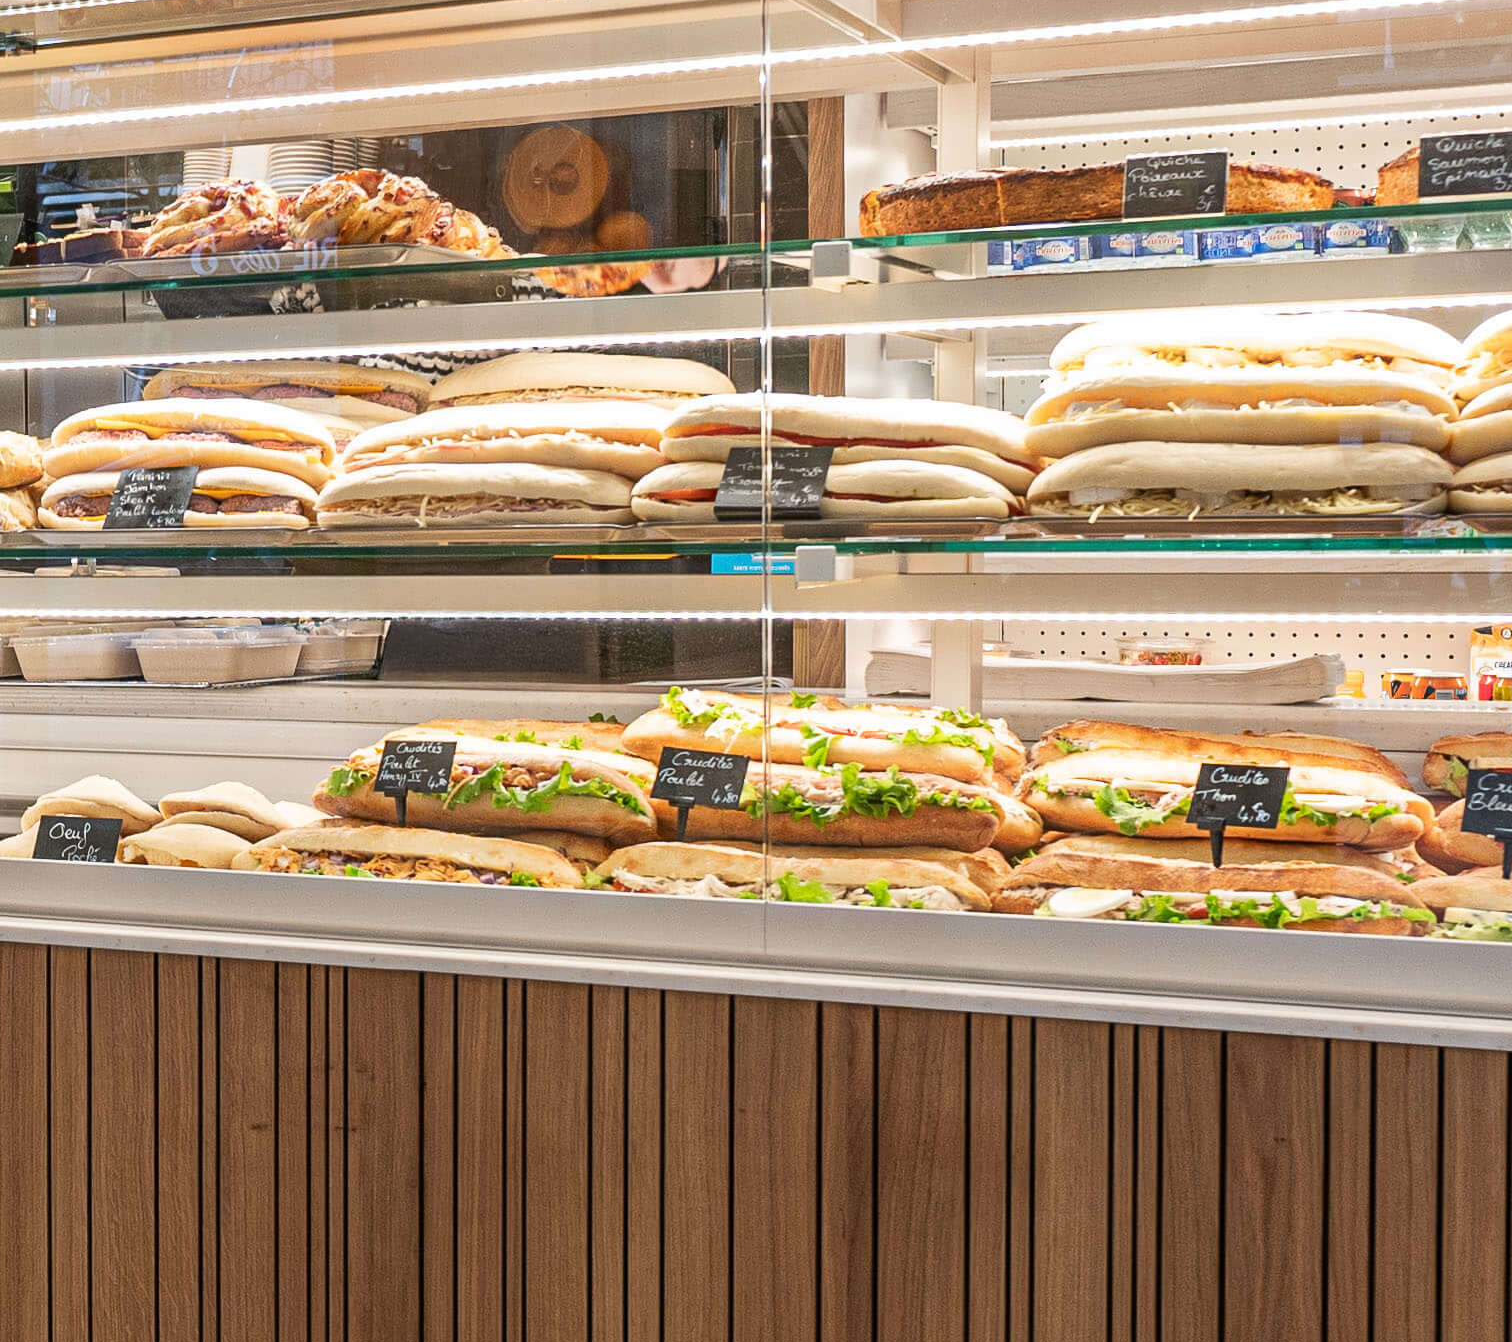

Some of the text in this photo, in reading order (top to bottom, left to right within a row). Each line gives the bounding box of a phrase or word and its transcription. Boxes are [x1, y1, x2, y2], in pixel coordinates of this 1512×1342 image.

[1436, 136, 1505, 153] Quiche
[1146, 156, 1205, 169] Quiche
[1428, 155, 1504, 170] Saumon
[1128, 168, 1207, 183] Poireaux
[124, 483, 166, 495] Jambon
[396, 742, 443, 754] Crudités
[383, 755, 421, 769] Poulet
[672, 752, 733, 770] Crudités
[379, 771, 406, 788] Henry
[659, 767, 704, 787] Poulet
[1210, 767, 1269, 786] Crudités
[1194, 789, 1236, 801] Thon
[49, 822, 92, 849] Oeuf
